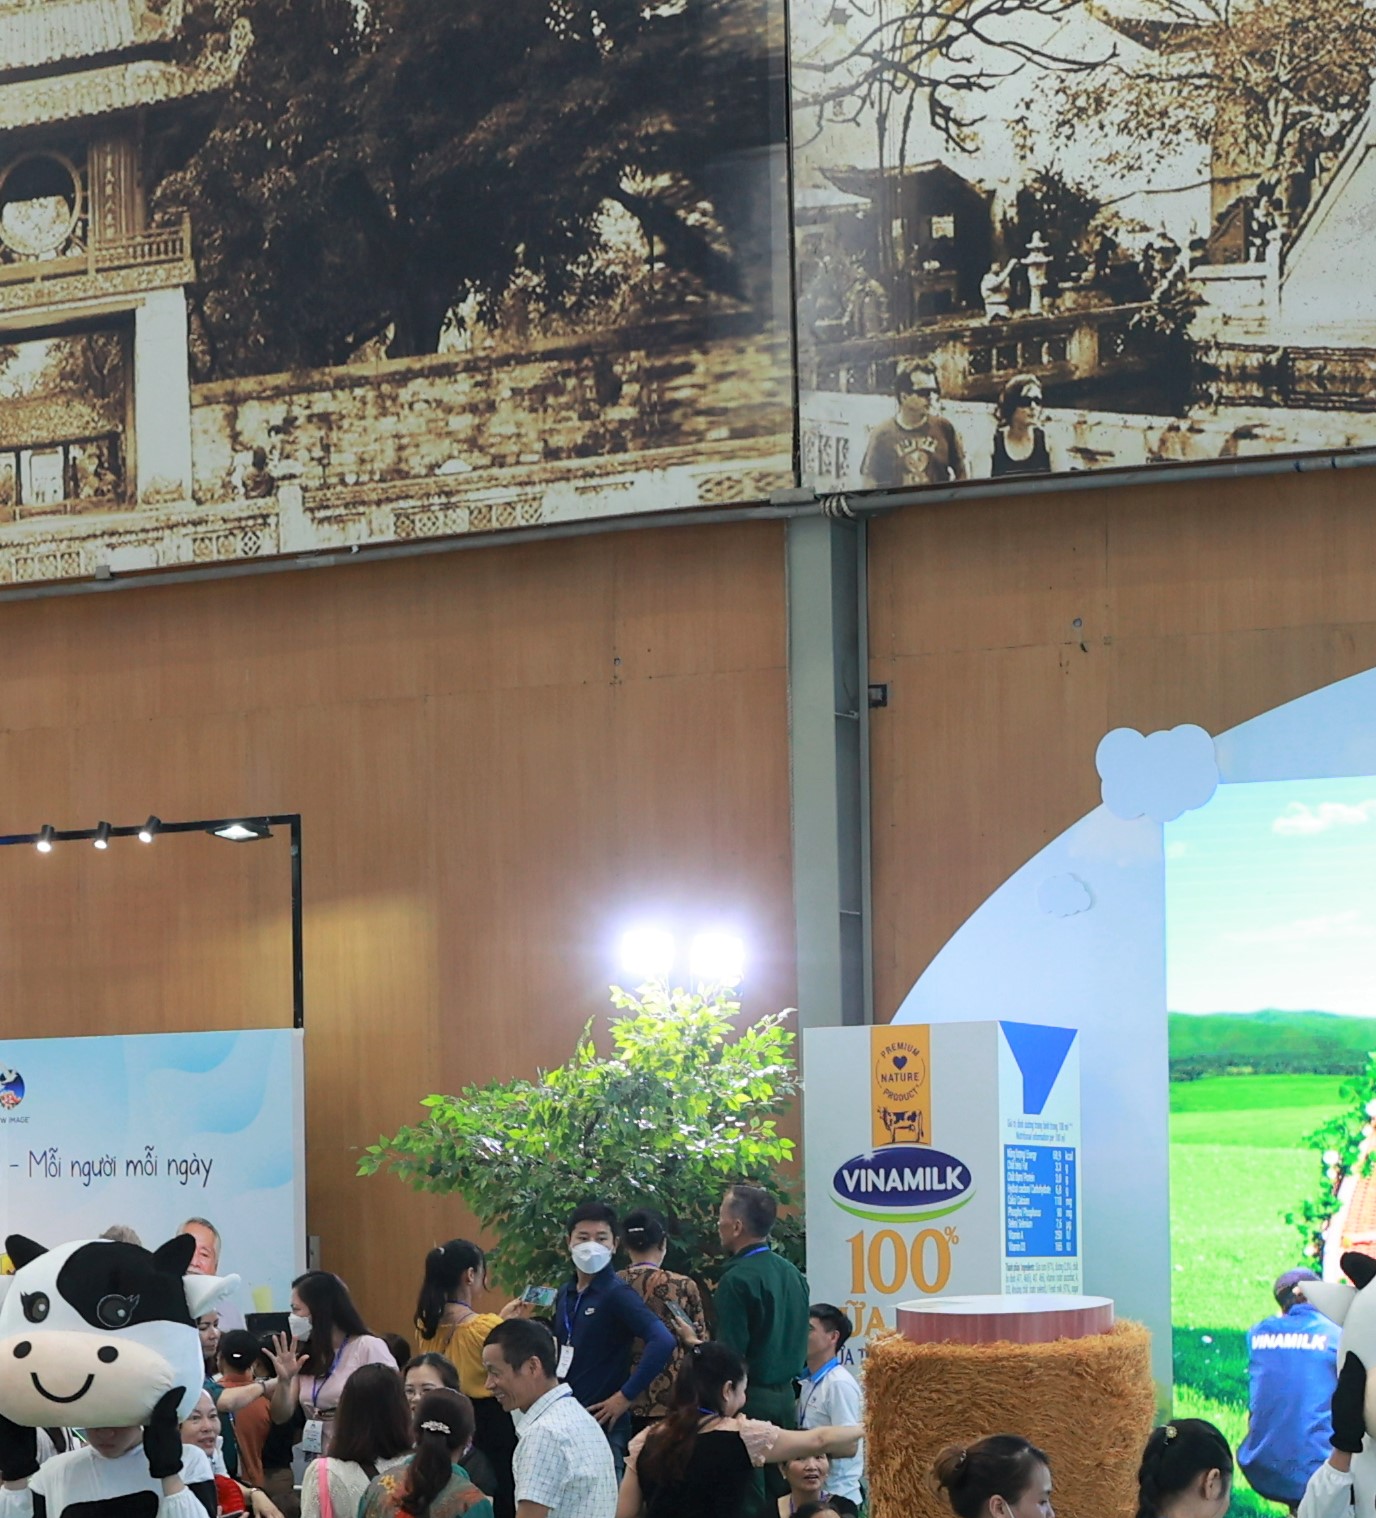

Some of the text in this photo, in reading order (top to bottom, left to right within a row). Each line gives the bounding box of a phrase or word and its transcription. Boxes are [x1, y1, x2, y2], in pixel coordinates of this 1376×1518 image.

[881, 1042, 920, 1058] PREMIUM
[881, 1072, 920, 1082] NATURE
[883, 1085, 918, 1101] PRODUCT
[28, 1147, 62, 1178] Mỗi
[71, 1153, 117, 1187] người
[125, 1145, 158, 1177] mỗi
[167, 1153, 213, 1188] ngày
[842, 1165, 965, 1193] VINAMILK
[842, 1300, 886, 1338] ỮA
[1251, 1332, 1327, 1351] VINAMILK
